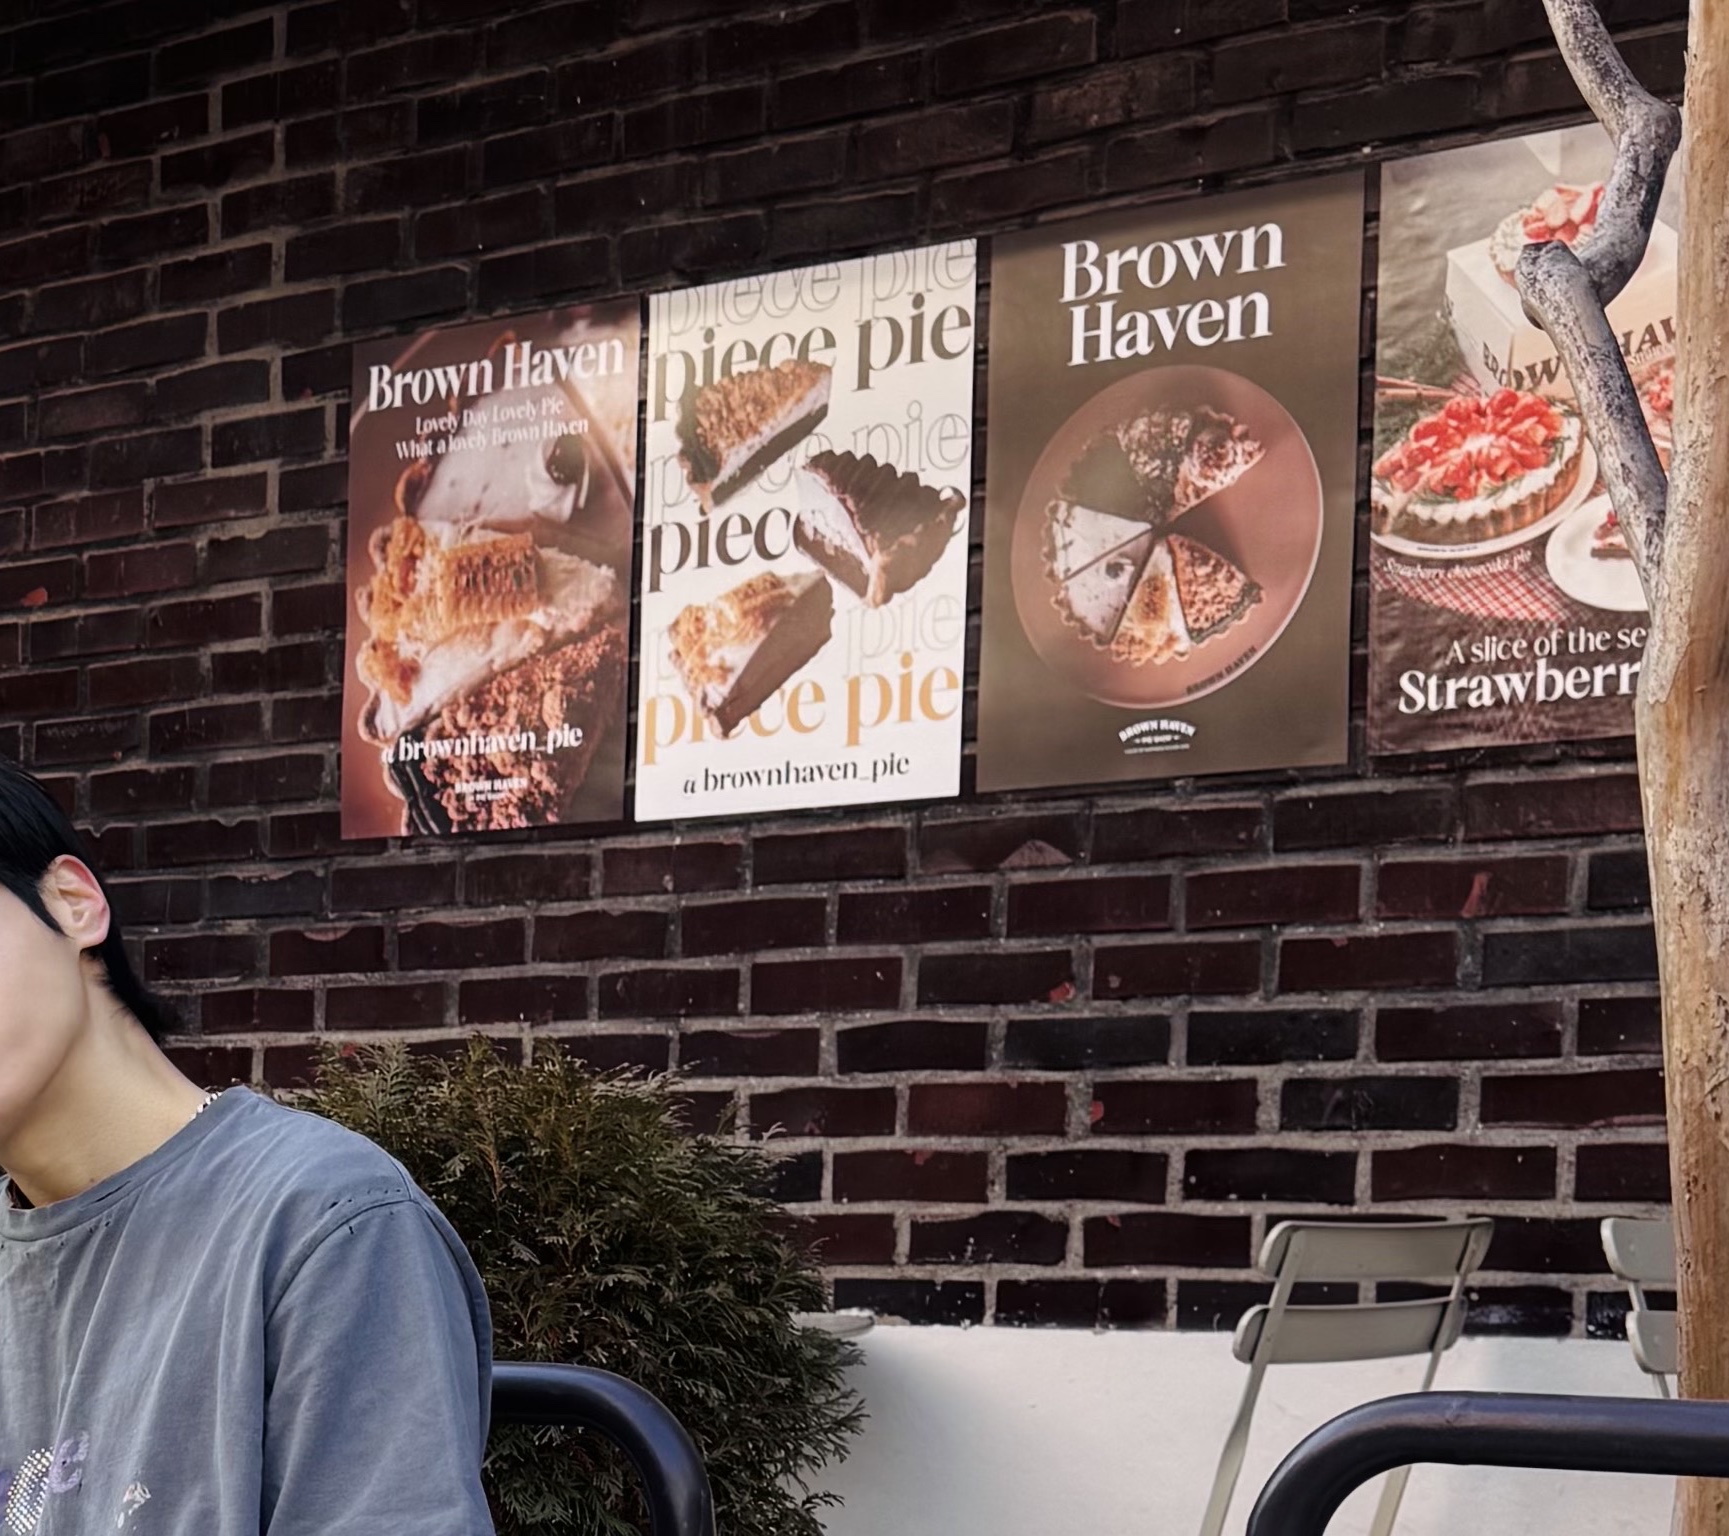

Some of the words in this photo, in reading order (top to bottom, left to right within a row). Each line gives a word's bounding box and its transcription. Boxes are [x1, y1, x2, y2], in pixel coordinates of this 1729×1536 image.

[1058, 222, 1287, 303] Brown
[852, 292, 972, 392] pie
[1066, 291, 1273, 367] Haven
[368, 358, 493, 412] Brown
[503, 337, 624, 391] Haven
[395, 439, 433, 461] What
[436, 441, 446, 454] a
[491, 425, 540, 447] Brown
[542, 418, 589, 438] Haven
[415, 410, 460, 436] Lovely
[462, 407, 489, 429] Day
[492, 400, 538, 422] Lovely
[648, 504, 797, 593] piec
[1445, 640, 1466, 666] A
[1471, 635, 1527, 664] slice
[1533, 629, 1565, 657] of
[1568, 626, 1611, 654] the
[1617, 626, 1650, 650] se
[642, 679, 827, 766] pice
[843, 652, 960, 747] pie
[1397, 658, 1641, 715] Strawberr
